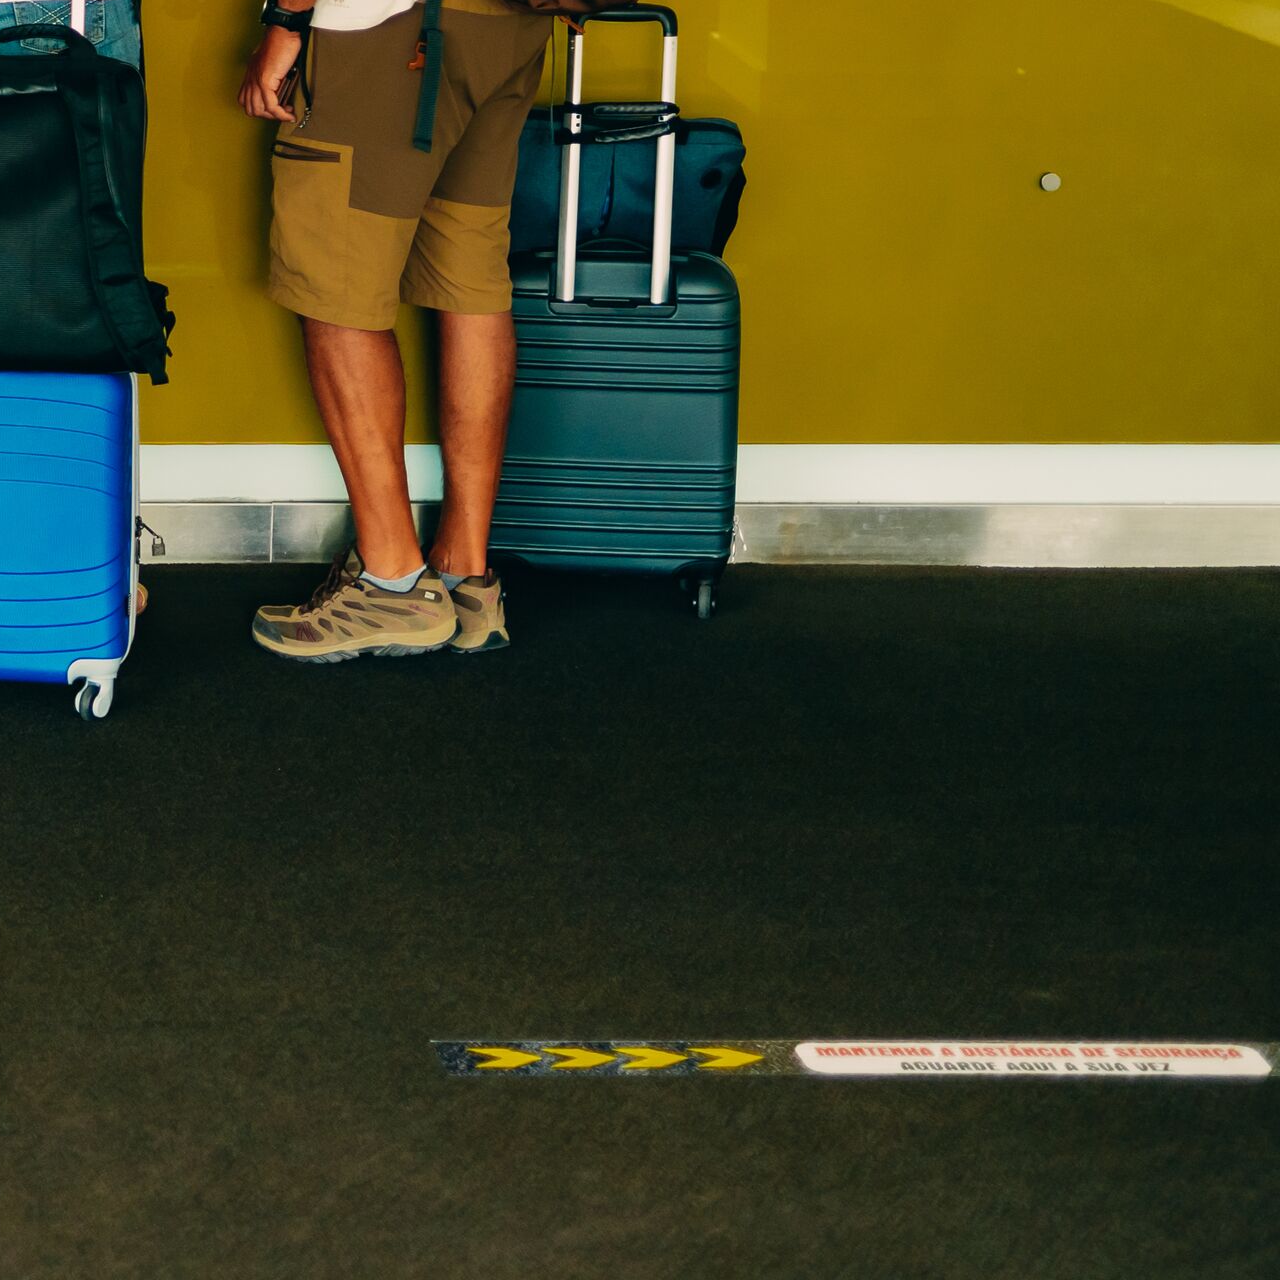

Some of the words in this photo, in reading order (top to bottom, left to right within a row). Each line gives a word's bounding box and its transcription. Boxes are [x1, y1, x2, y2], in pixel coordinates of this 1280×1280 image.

[815, 1047, 933, 1057] MANTENHA
[939, 1047, 955, 1057] A
[959, 1045, 1075, 1058] DISTÂNCIA
[1079, 1047, 1105, 1058] DE
[1113, 1047, 1243, 1061] SEGURANÇA
[900, 1061, 999, 1071] AGUARDE
[1006, 1061, 1057, 1072] AQUI
[1065, 1062, 1078, 1072] A
[1087, 1062, 1128, 1072] SUA
[1133, 1062, 1175, 1072] VEZ
